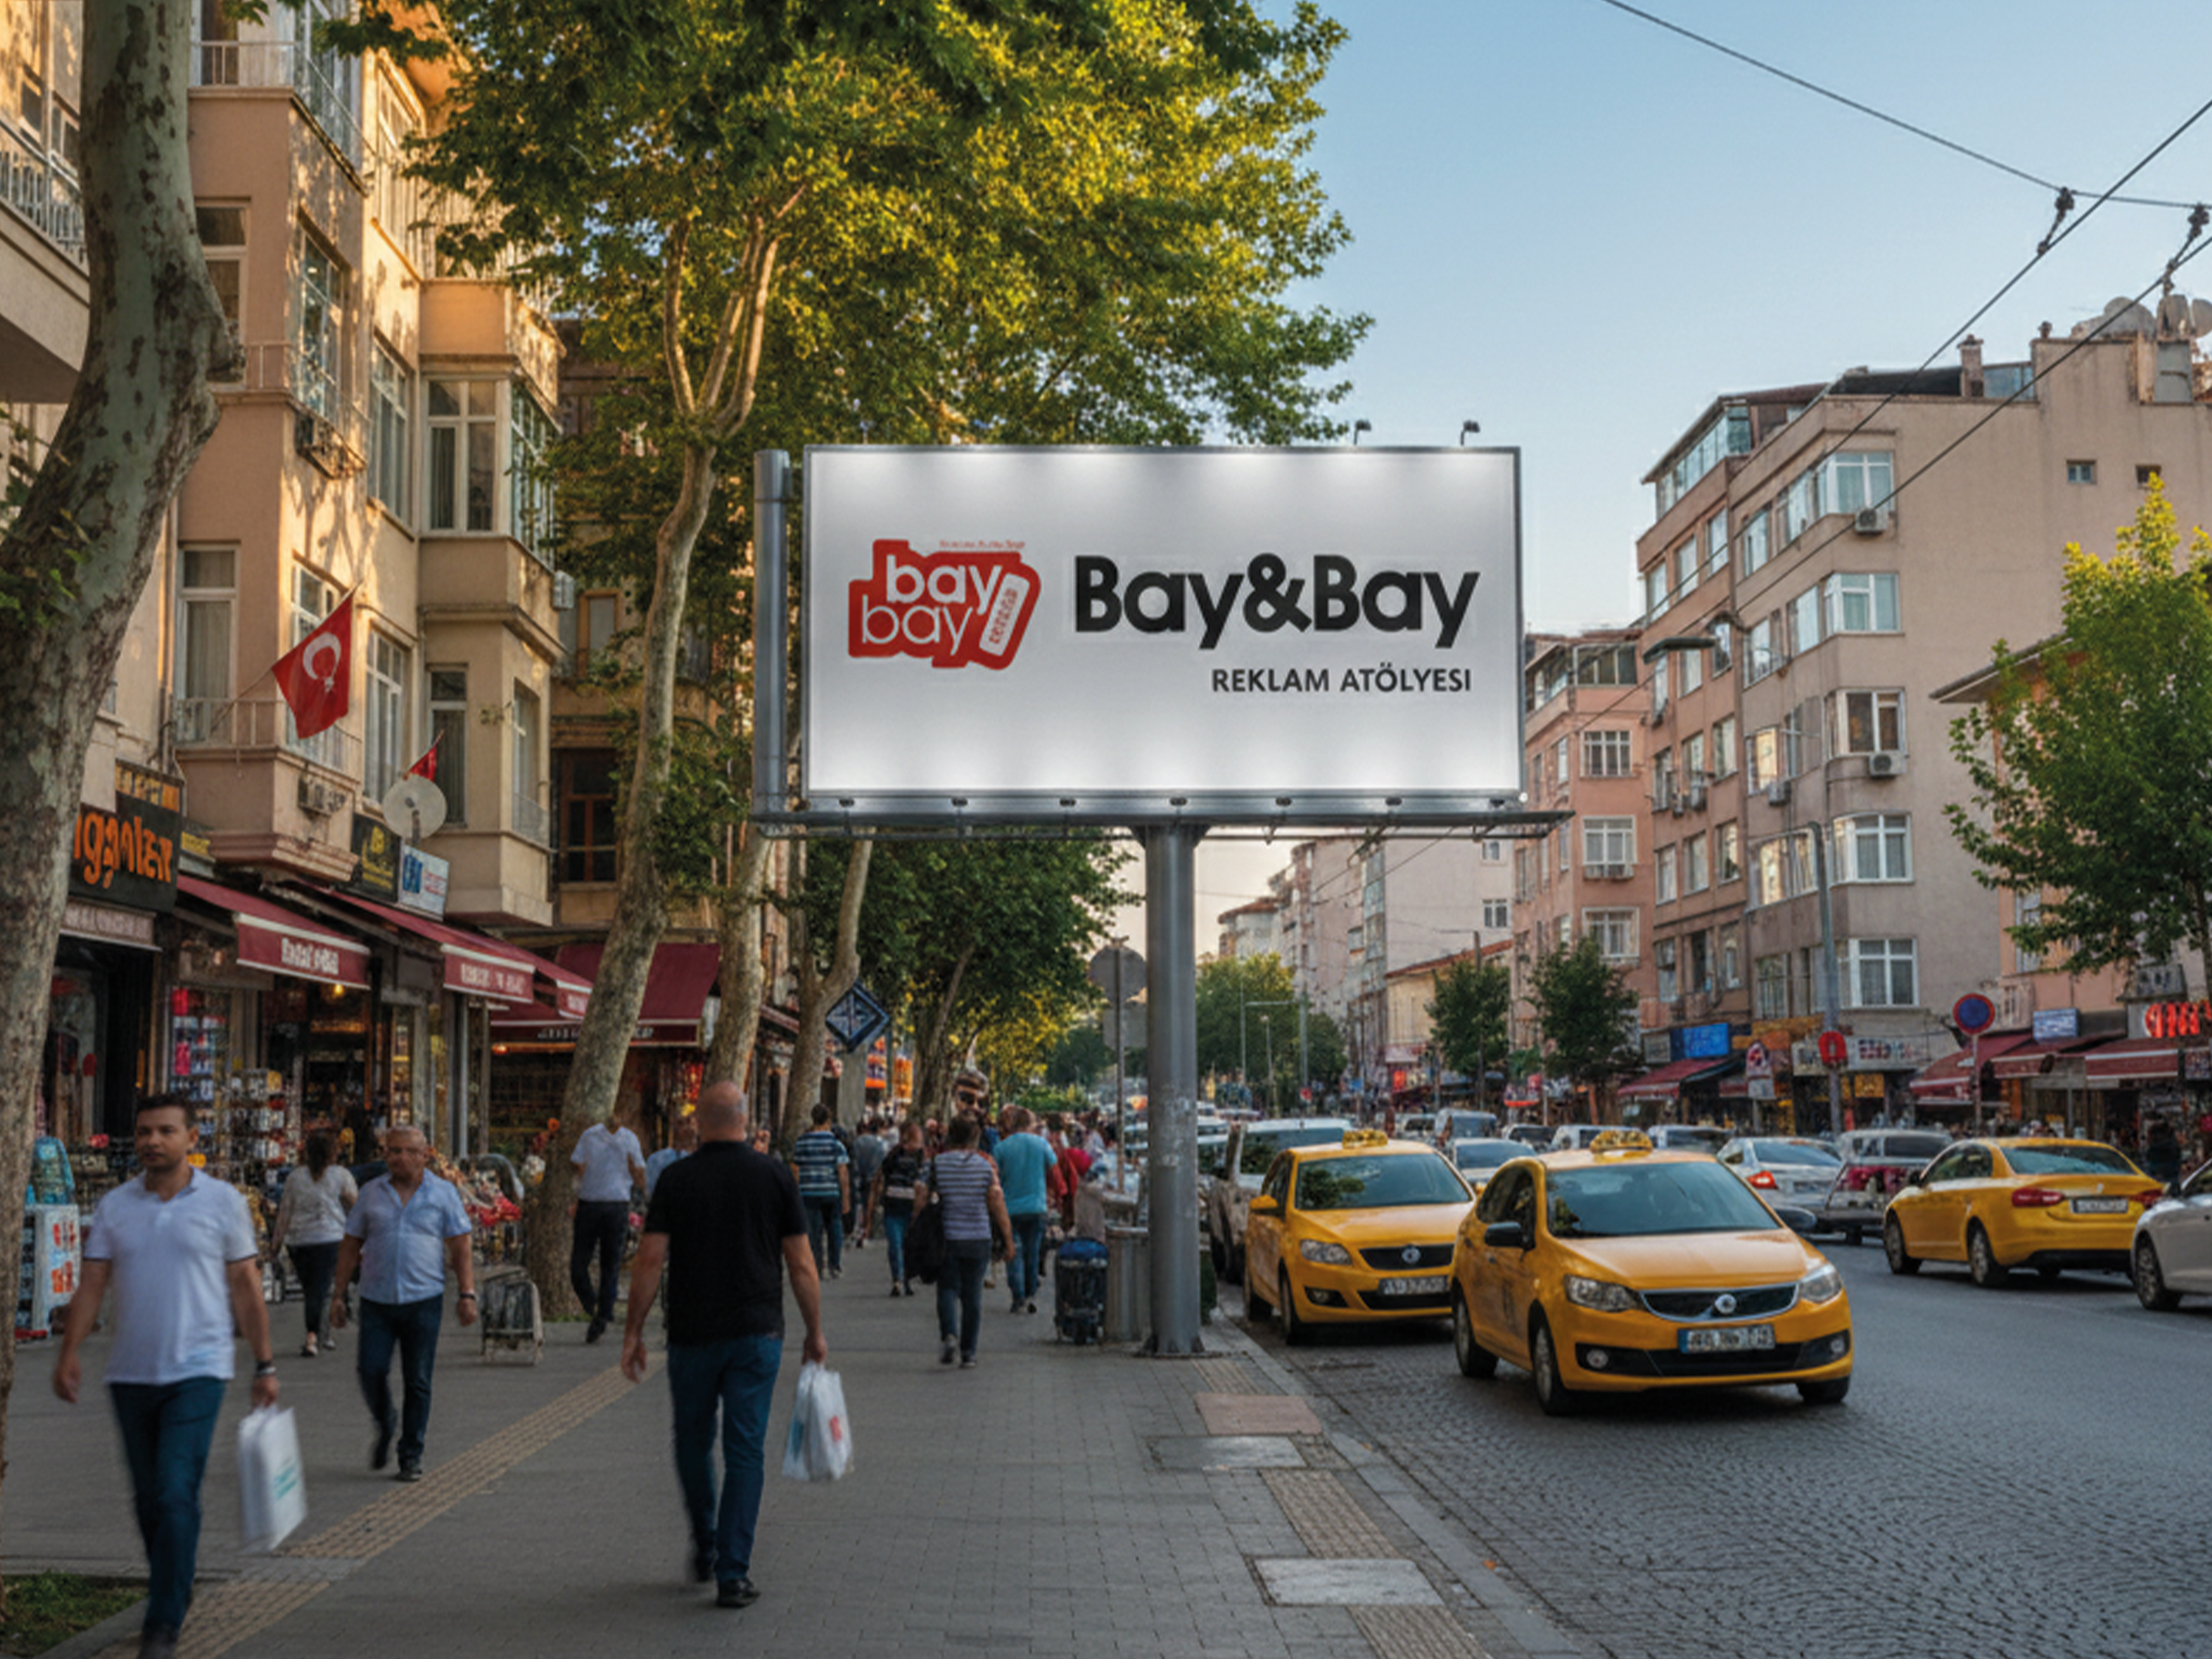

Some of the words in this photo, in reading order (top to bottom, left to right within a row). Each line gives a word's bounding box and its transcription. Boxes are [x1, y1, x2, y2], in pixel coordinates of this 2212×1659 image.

[886, 554, 1001, 615] bay
[1074, 553, 1481, 650] Bay&Bay
[862, 594, 973, 655] bay
[1212, 669, 1329, 692] REKLAM
[1340, 662, 1470, 692] ATÖLYESI
